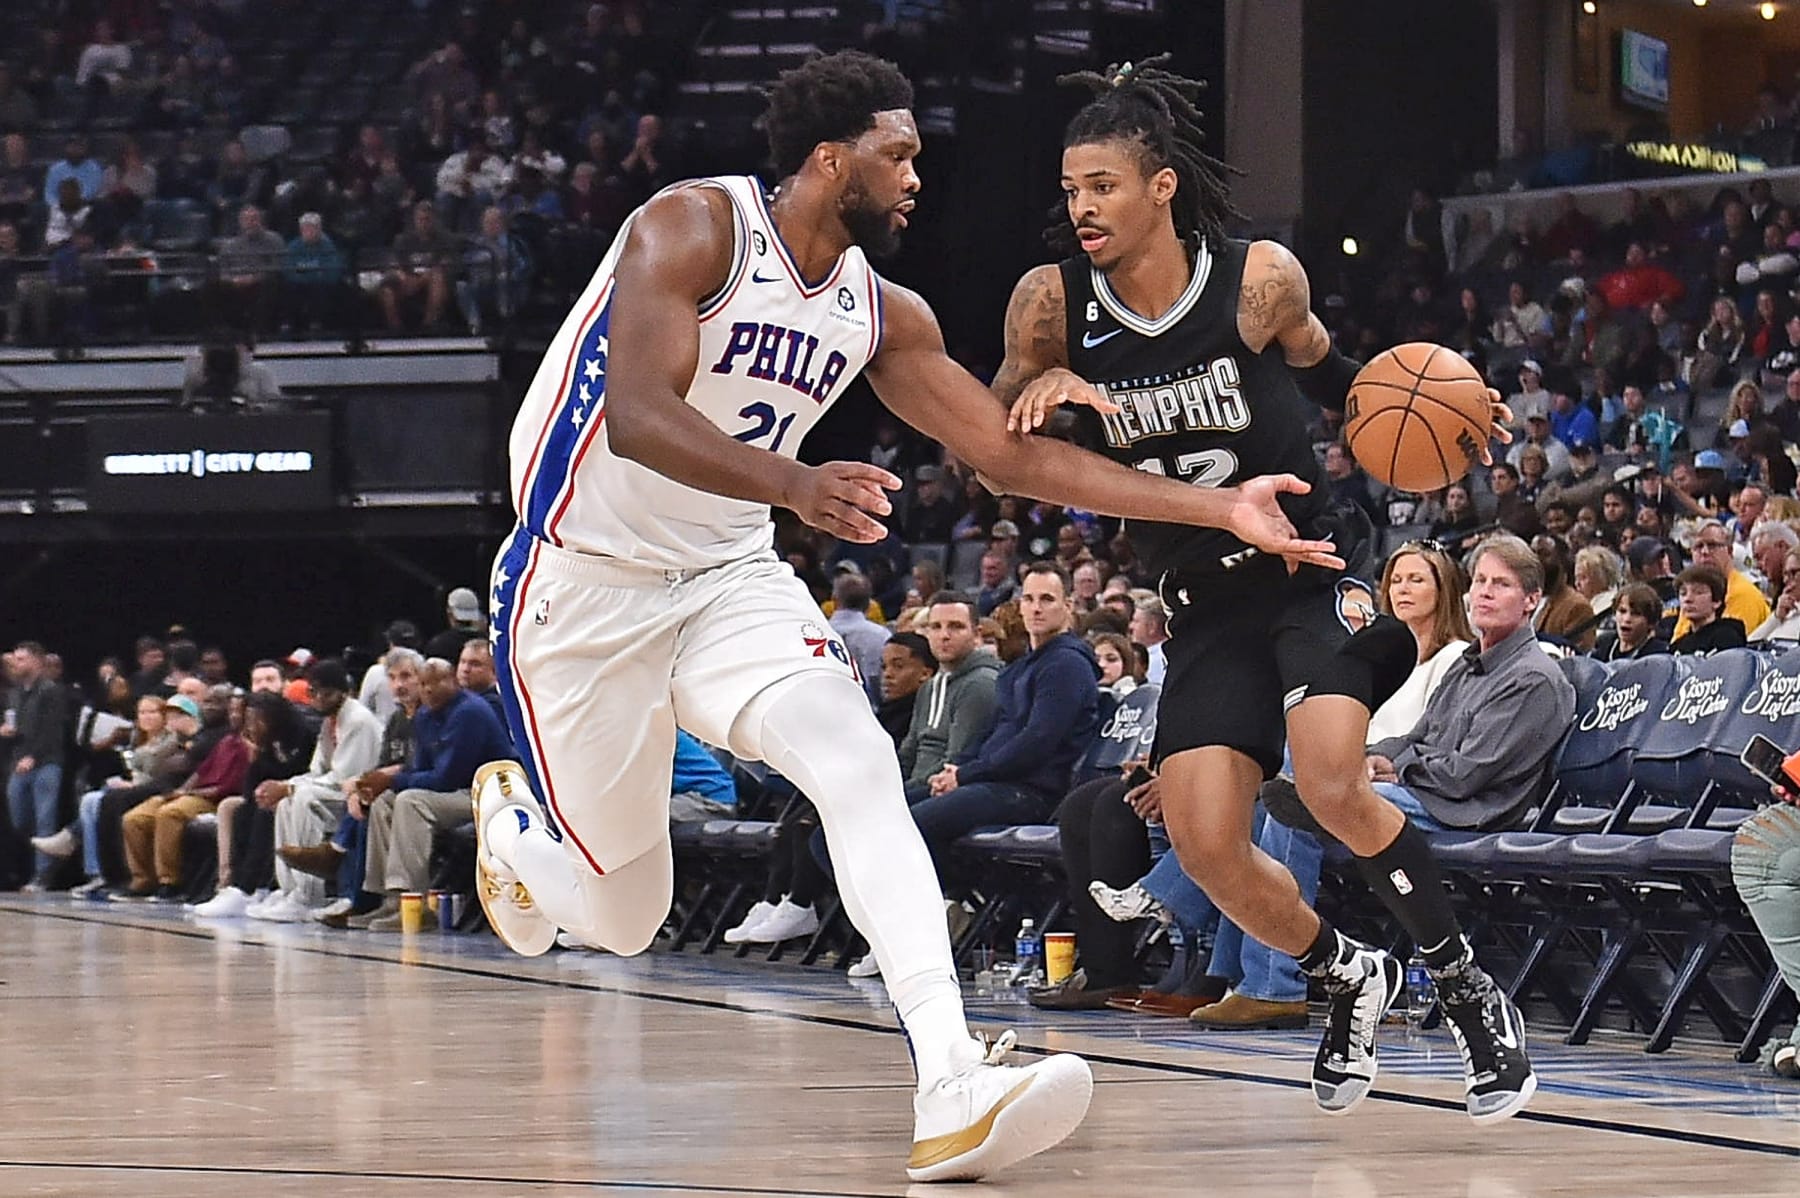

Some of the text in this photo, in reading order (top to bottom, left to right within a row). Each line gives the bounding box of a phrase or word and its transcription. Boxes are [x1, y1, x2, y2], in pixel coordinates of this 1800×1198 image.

[1086, 301, 1099, 321] 6
[711, 322, 847, 405] PHILA
[1110, 363, 1205, 390] GRIZZLIES
[1092, 356, 1250, 448] MEMPHIS
[732, 402, 796, 453] 21
[205, 453, 255, 473] CITY
[803, 637, 849, 666] 76
[1742, 668, 1800, 715] Sissy
